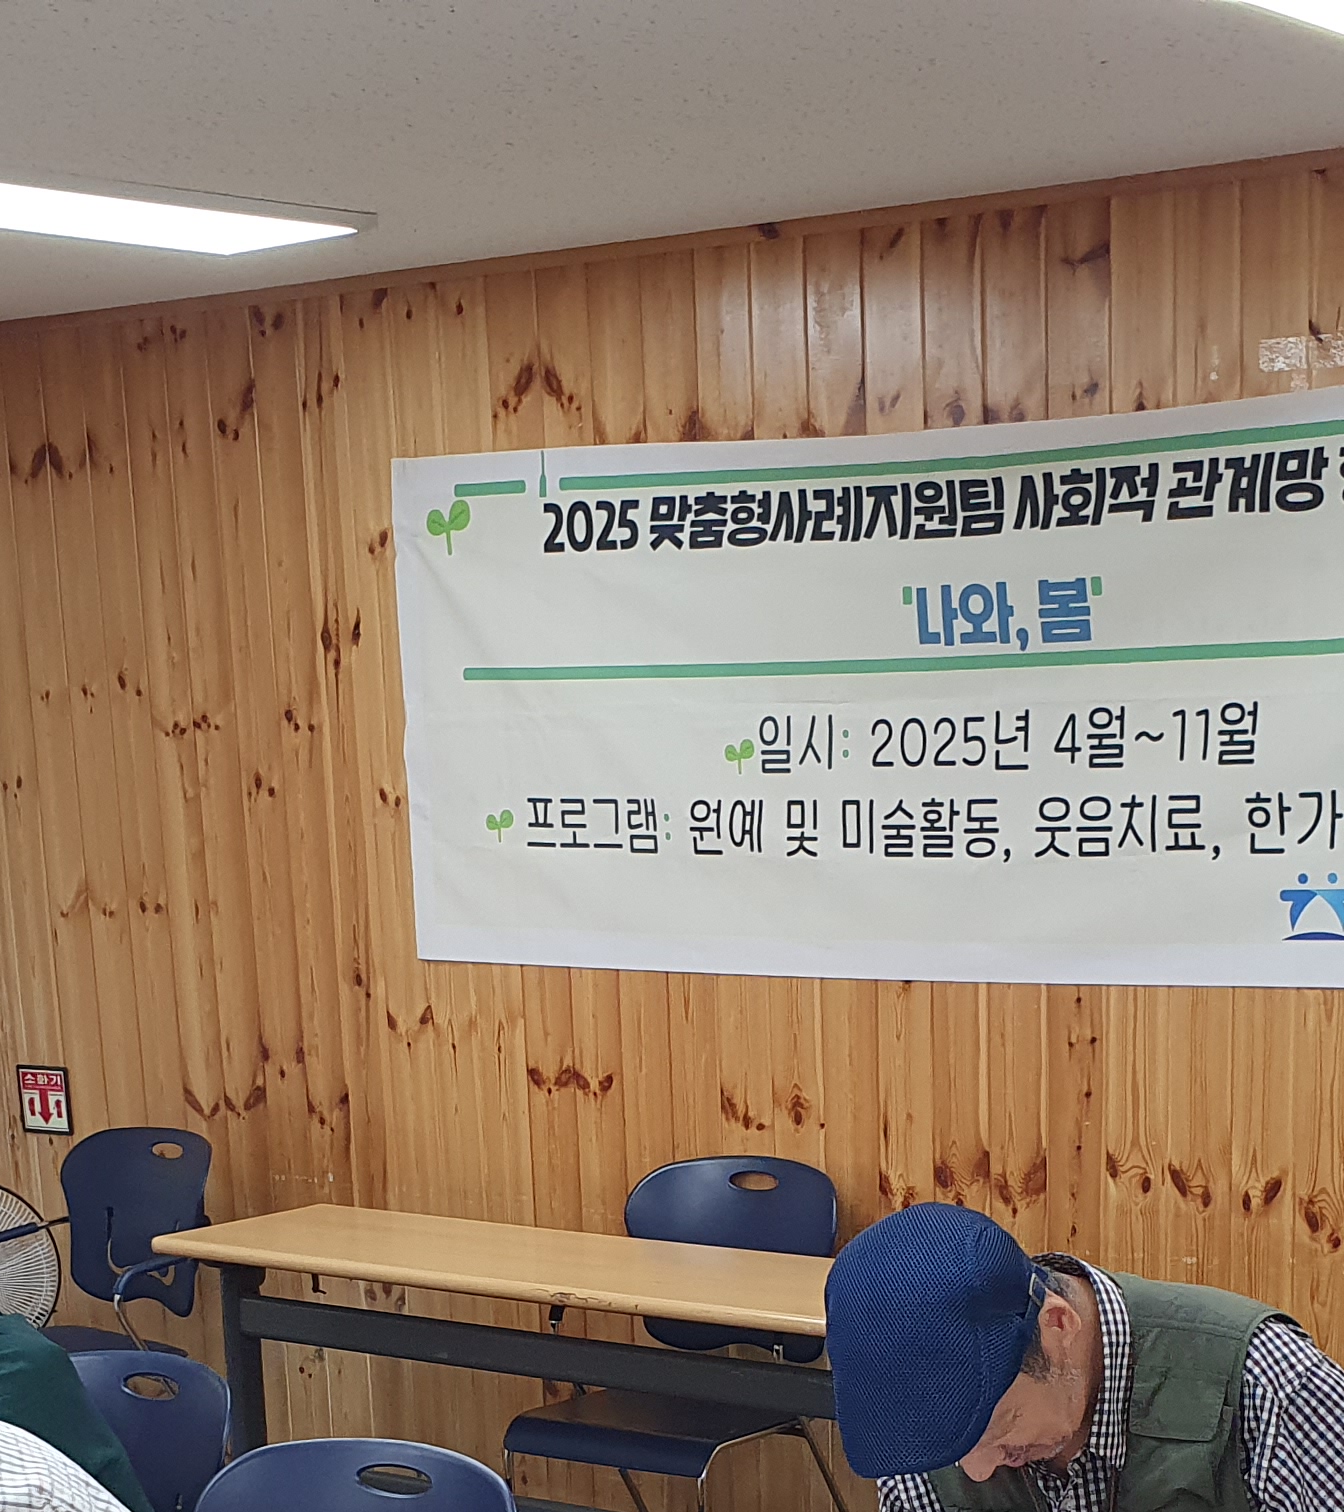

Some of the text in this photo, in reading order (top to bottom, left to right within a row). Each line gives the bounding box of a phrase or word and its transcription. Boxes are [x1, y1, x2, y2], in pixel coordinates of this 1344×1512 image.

[543, 499, 640, 553] 2025
[648, 476, 1006, 551] 맞춤형사례지원팀
[1013, 463, 1159, 531] 사회적
[1166, 446, 1329, 521] 관계망
[758, 700, 1259, 774] 일시: 2025년 4월~11월
[526, 797, 671, 854] 프로그램:
[689, 799, 764, 856] 원예
[786, 799, 819, 858] 및
[841, 797, 1012, 862] 미술활동,
[1034, 794, 1221, 861] 웃음치료,
